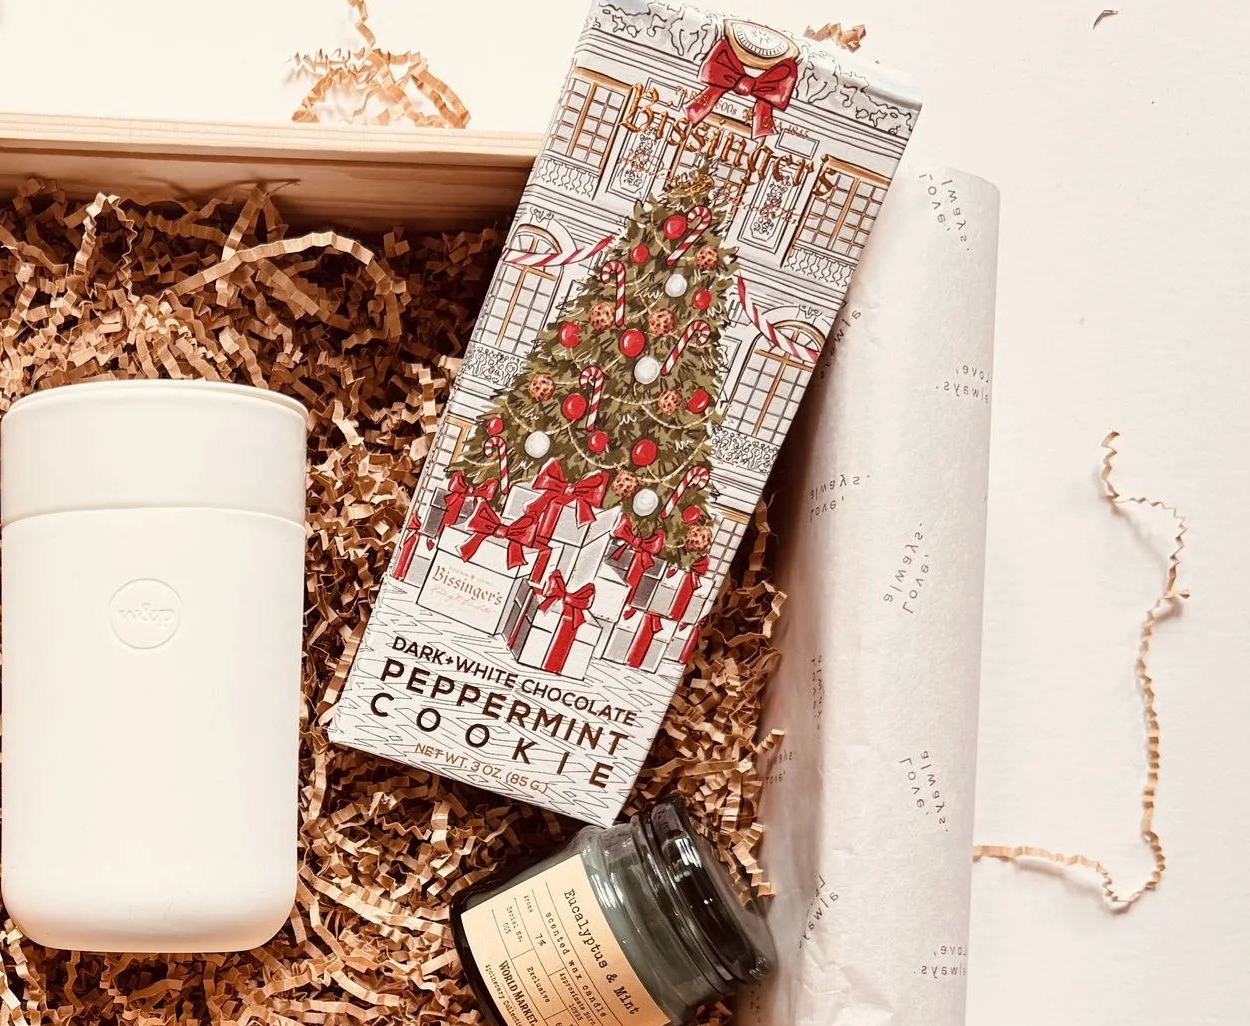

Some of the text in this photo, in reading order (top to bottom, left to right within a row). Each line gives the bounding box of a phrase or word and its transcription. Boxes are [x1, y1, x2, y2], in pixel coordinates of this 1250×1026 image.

[620, 82, 837, 198] Bissinger's
[432, 565, 503, 606] Bissinger's
[379, 658, 630, 757] PEPPERMINT
[521, 678, 638, 727] CHOCOLATE
[369, 692, 615, 789] COOKIE
[415, 742, 444, 760] NET
[445, 752, 468, 770] WT.
[471, 760, 481, 773] 3
[482, 763, 503, 781] OZ.
[506, 771, 530, 787] (85
[498, 959, 518, 992] WORLD
[545, 911, 570, 956] scented
[568, 958, 583, 981] wax
[582, 984, 607, 1018] candle
[564, 887, 641, 1015] Eucalyptus & Mint
[484, 963, 505, 1000] Apothecary
[526, 966, 551, 1004] Exclusive
